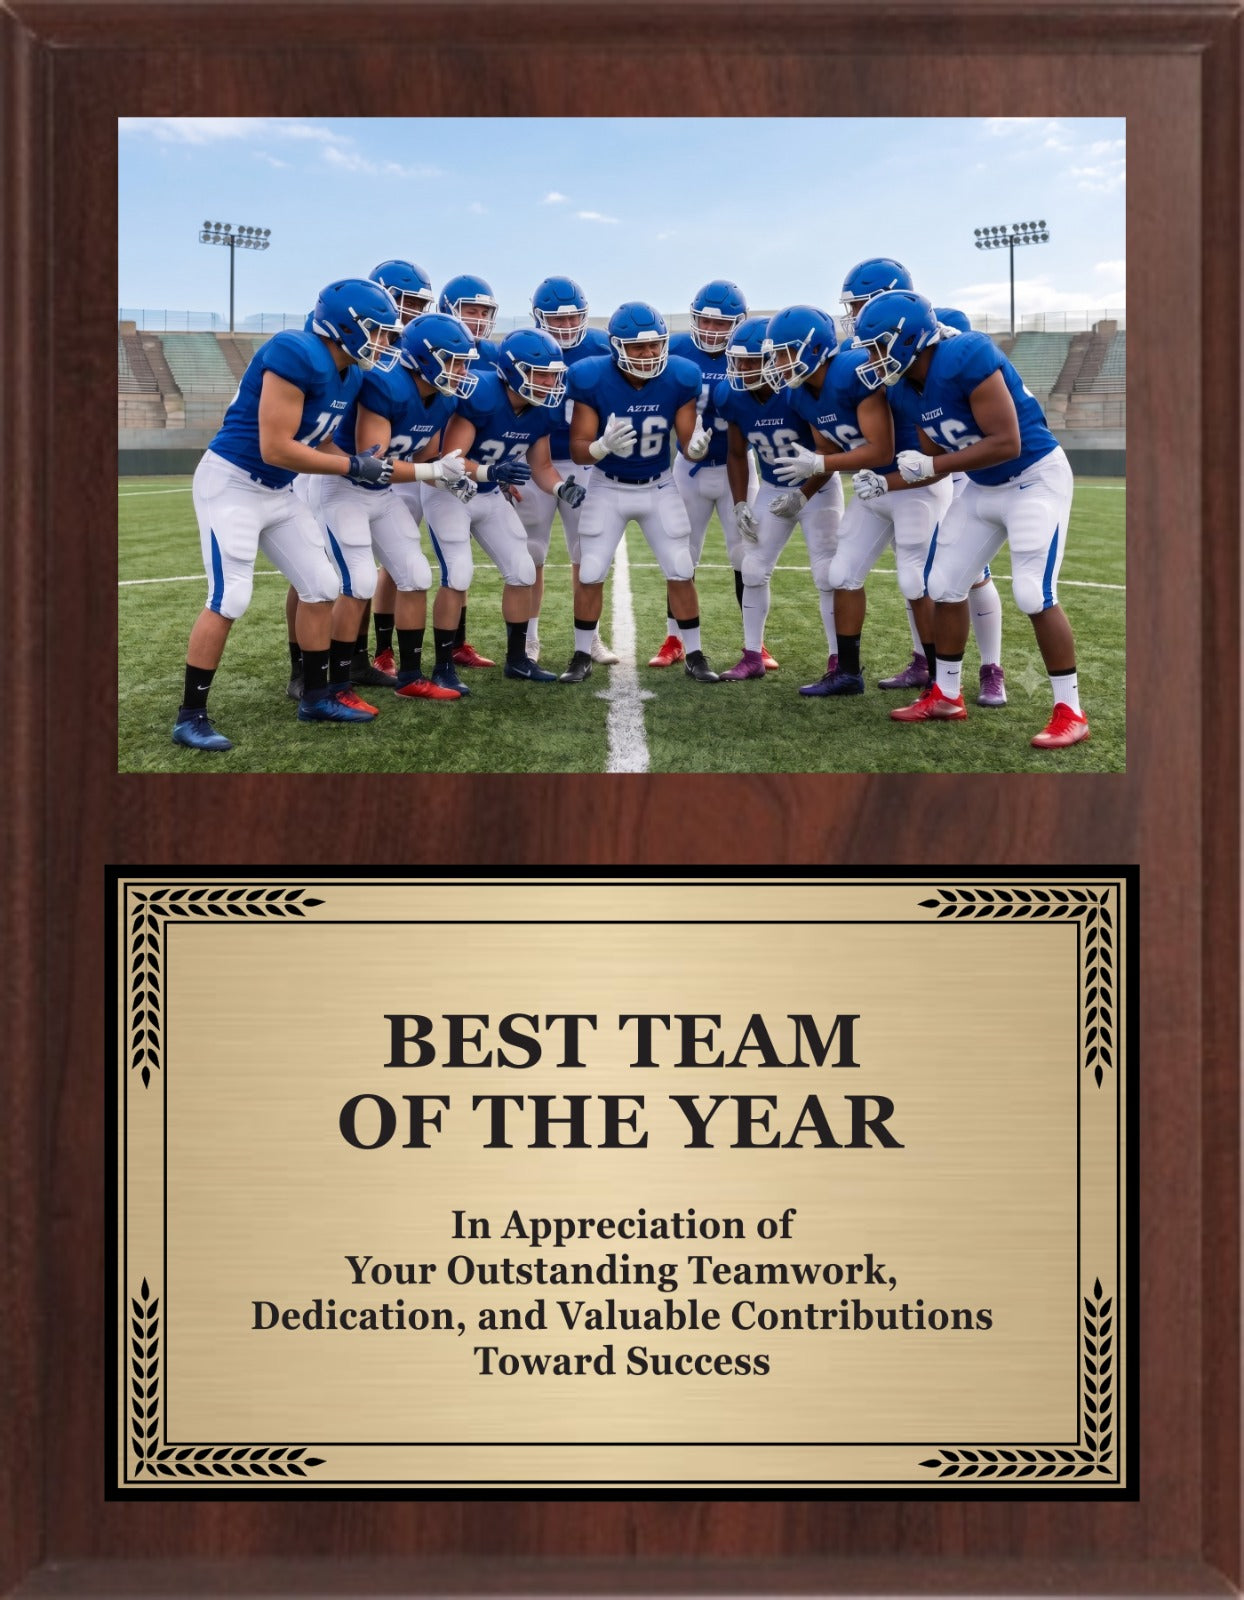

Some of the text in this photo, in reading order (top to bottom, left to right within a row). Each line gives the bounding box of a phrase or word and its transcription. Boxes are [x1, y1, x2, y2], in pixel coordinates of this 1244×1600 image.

[383, 1013, 861, 1069] BEST TEAM
[339, 1093, 905, 1150] OF THE YEAR
[451, 1208, 797, 1248] In Appreciation of
[344, 1253, 897, 1293] Your Outstanding Teamwork,
[251, 1298, 993, 1337] Dedication, and Valuable Contributions
[473, 1344, 770, 1376] Toward Success
